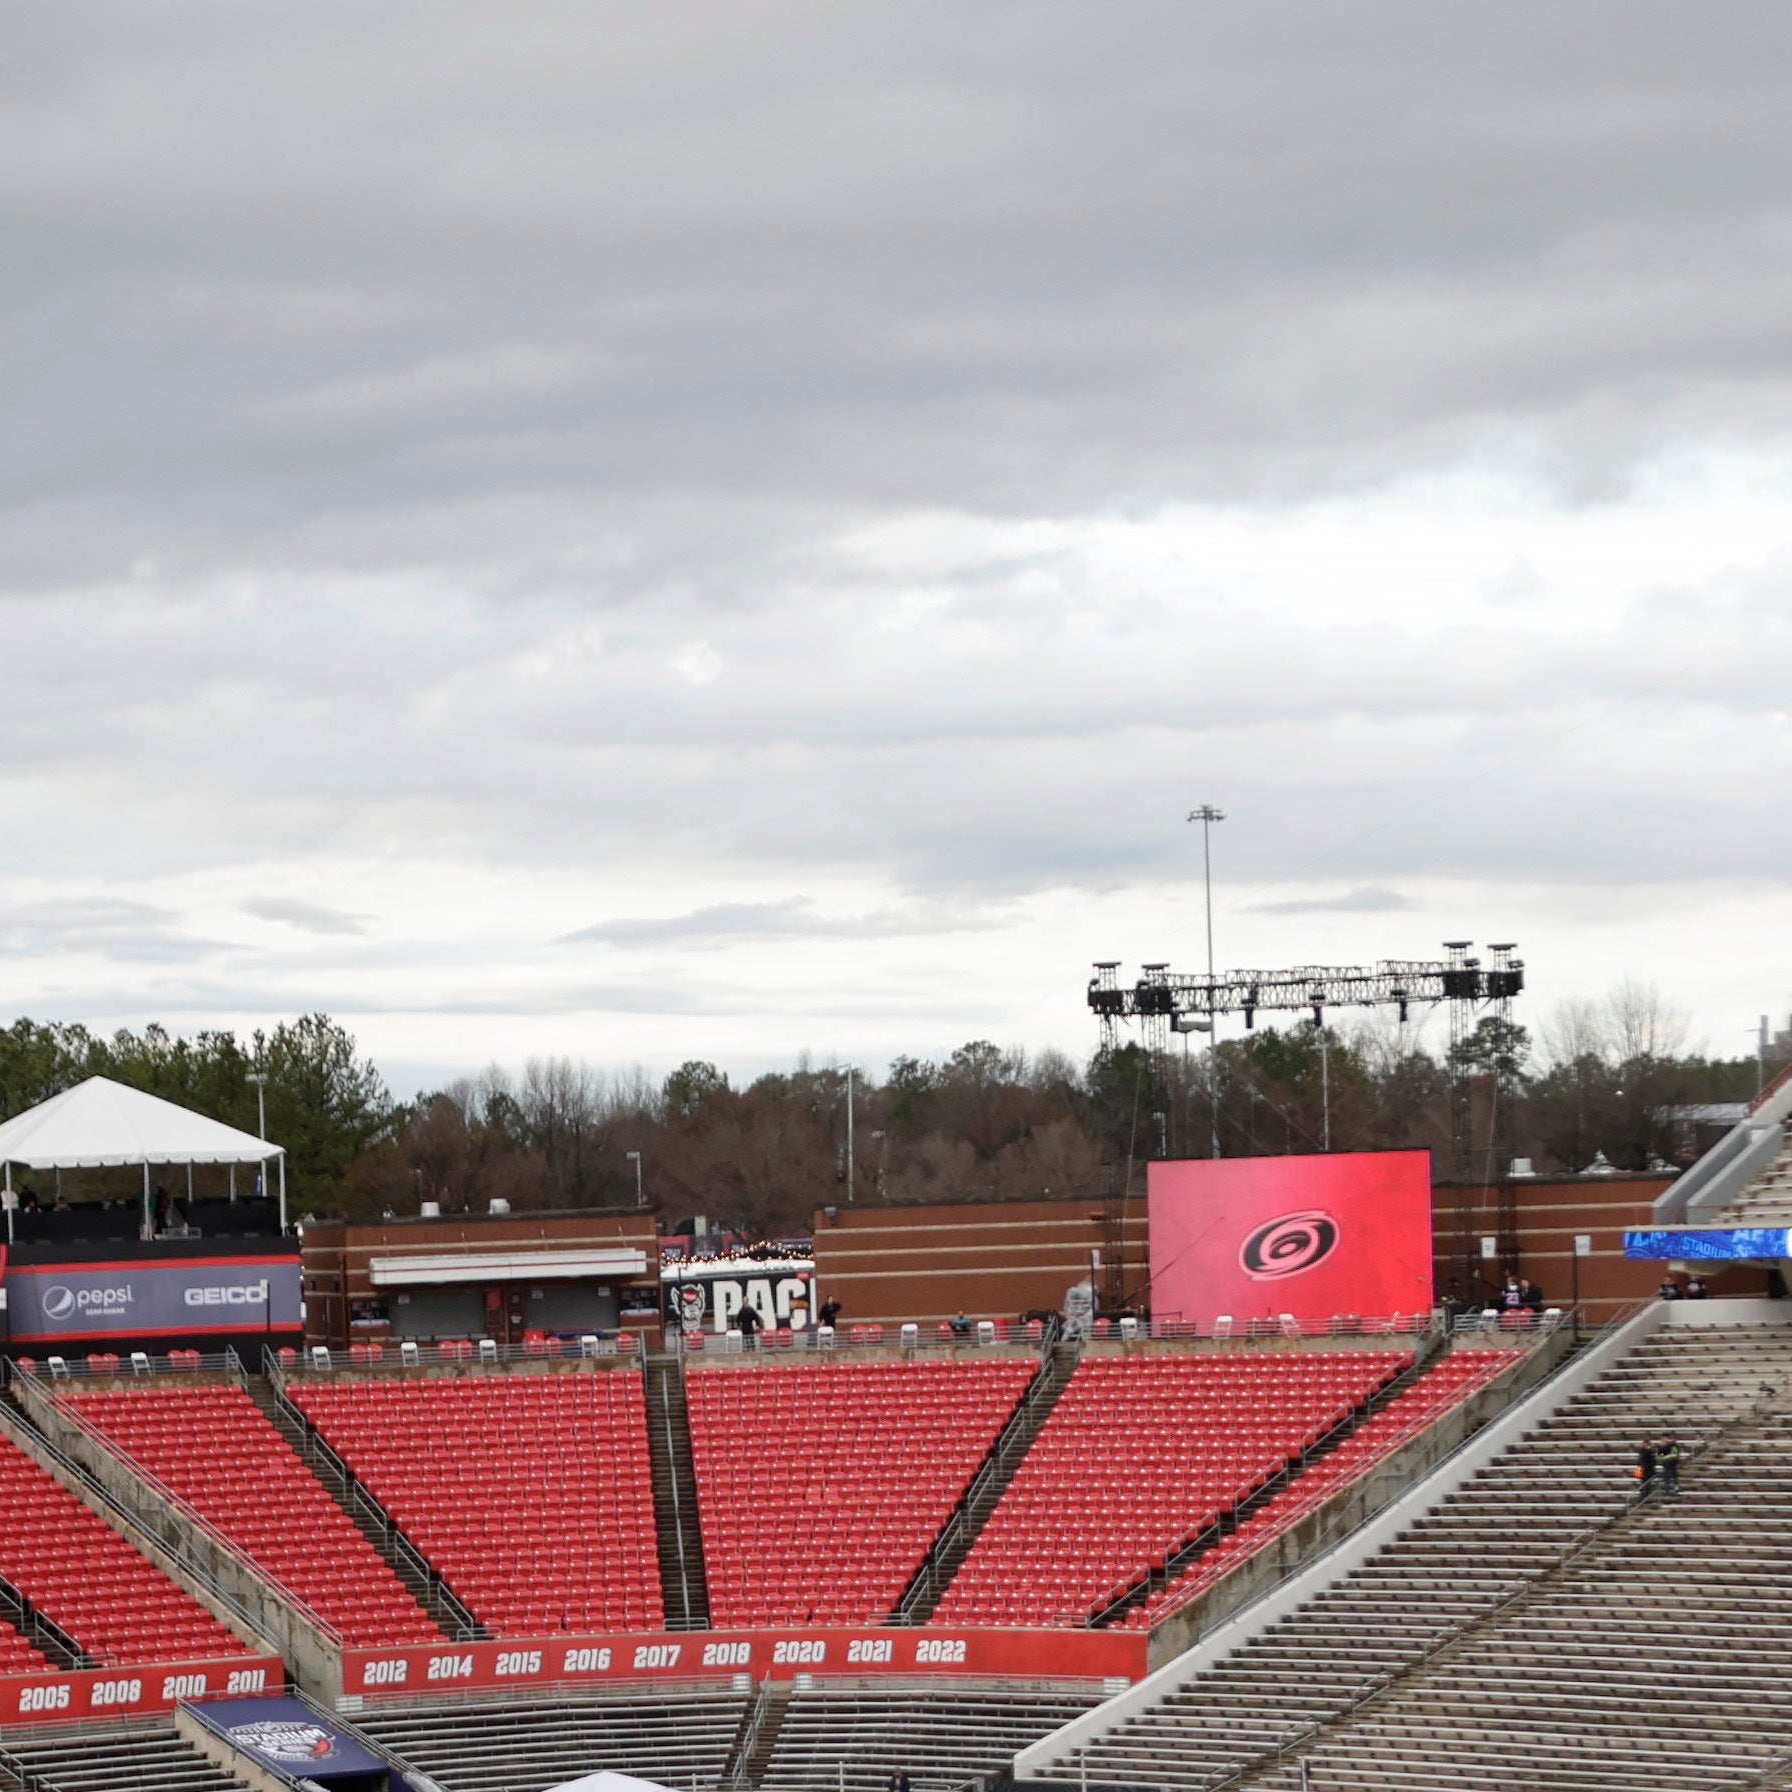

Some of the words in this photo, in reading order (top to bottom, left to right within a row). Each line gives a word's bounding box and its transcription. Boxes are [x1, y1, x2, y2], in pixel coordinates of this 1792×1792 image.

[77, 1284, 133, 1308] pepsi
[184, 1284, 264, 1306] GEICO
[495, 1650, 542, 1675] 2015
[563, 1647, 612, 1672] 2016
[633, 1644, 682, 1669] 2017
[702, 1641, 751, 1666] 2018
[773, 1640, 826, 1664] 2020
[847, 1639, 894, 1663] 2021
[915, 1639, 967, 1663] 2022
[363, 1659, 408, 1685] 2012
[427, 1654, 473, 1679] 2014
[91, 1679, 142, 1706] 2008
[162, 1674, 207, 1700] 2010
[227, 1669, 266, 1695] 2011
[19, 1685, 71, 1712] 2005
